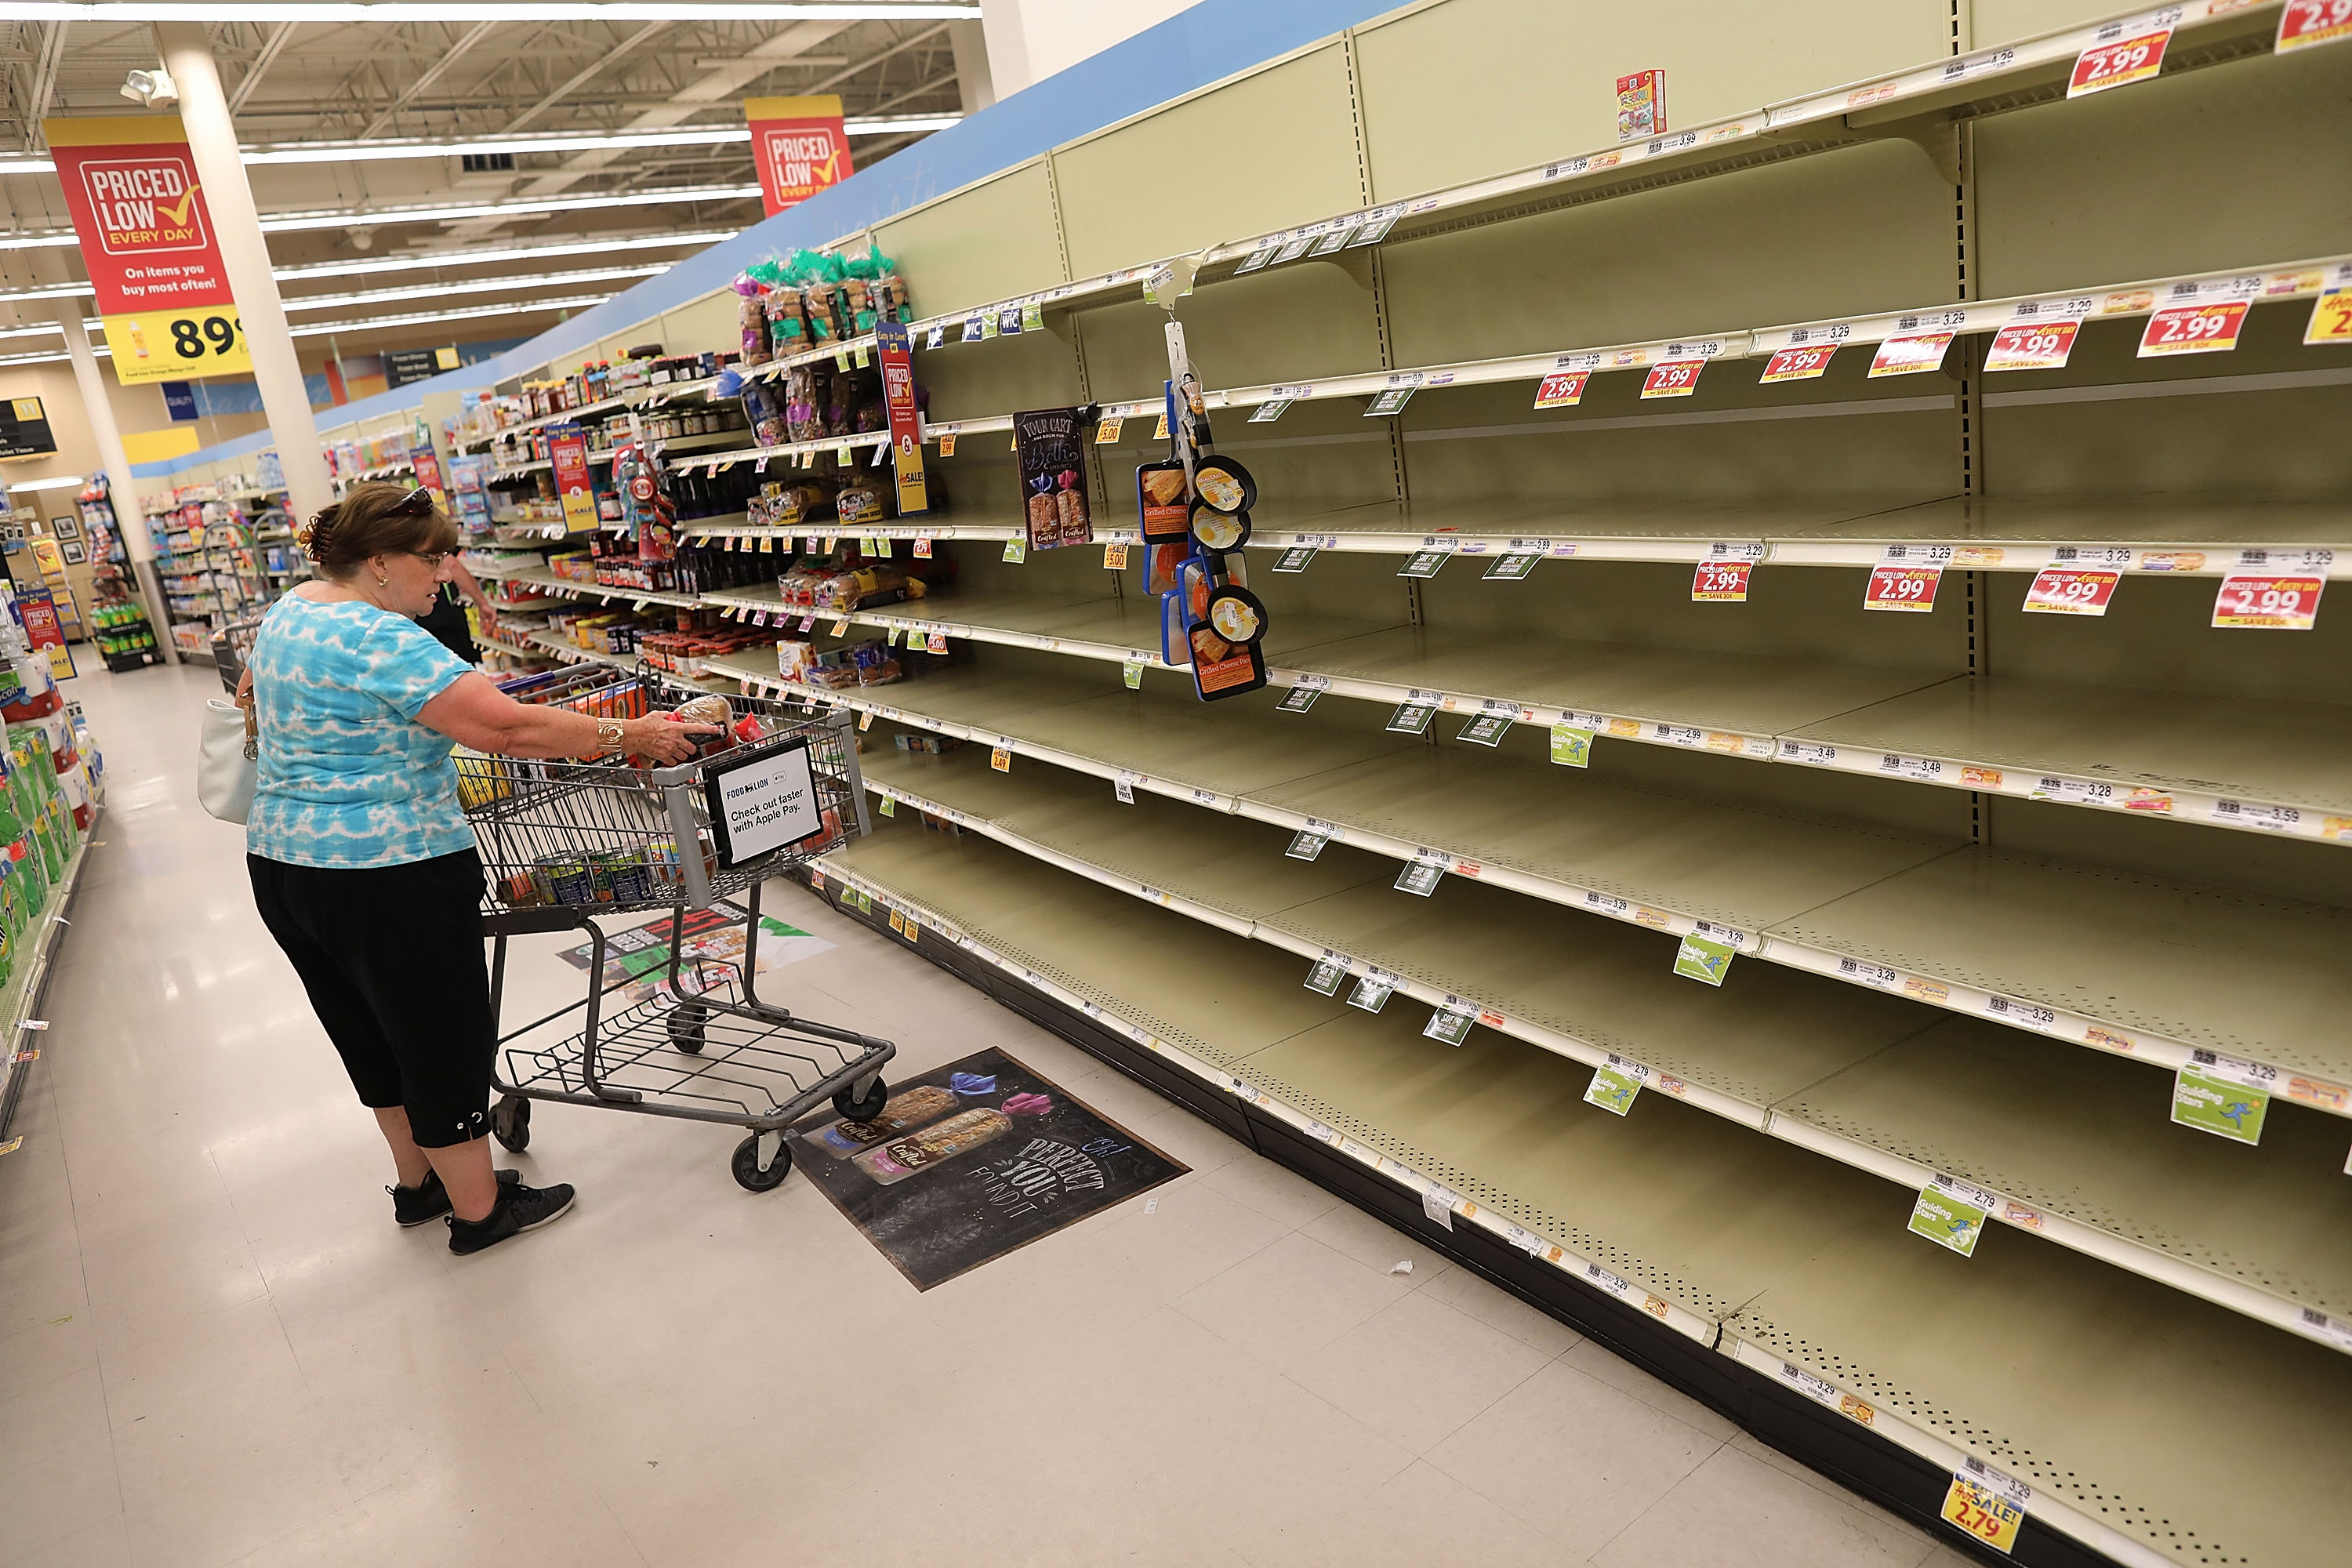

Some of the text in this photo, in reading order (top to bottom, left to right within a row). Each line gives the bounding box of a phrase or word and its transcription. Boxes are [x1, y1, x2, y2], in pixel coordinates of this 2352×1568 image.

[2087, 45, 2150, 81] 2.99
[1679, 133, 1696, 145] 3.99
[772, 136, 829, 163] PRICED
[776, 162, 811, 187] LOW
[91, 168, 183, 200] PRICED
[781, 186, 814, 198] EVERY
[100, 201, 156, 231] LOW
[110, 228, 194, 245] EVERY DAY
[125, 265, 205, 279] On items you
[122, 278, 216, 296] buy most often!
[2067, 300, 2092, 313] 3.29
[1943, 312, 1965, 325] 3.29
[1830, 326, 1849, 339] 3.29
[2160, 315, 2226, 342] 2.99
[1921, 336, 1937, 345] EVERY
[2003, 336, 2059, 358] 2.99
[1700, 343, 1717, 354] 3.29
[1585, 354, 1600, 365] 3.29
[1777, 353, 1820, 373] 2.99
[887, 368, 908, 383] PRICED
[1653, 369, 1690, 388] 2.99
[890, 383, 902, 397] LOW
[1545, 381, 1577, 398] 2.99
[20, 402, 36, 416] 11
[1023, 418, 1073, 437] YOUR CART
[557, 448, 579, 459] PRICED
[558, 457, 572, 466] LOW
[906, 471, 924, 483] SALE!
[1746, 545, 1762, 557] 3.29
[1930, 546, 1951, 559] 3.29
[2106, 550, 2130, 562] 3.29
[1703, 572, 1739, 590] 2.99
[1910, 572, 1927, 581] EVERY
[1879, 579, 1925, 600] 2.99
[2042, 581, 2099, 602] 2.99
[2233, 590, 2301, 614] 2.99
[31, 618, 43, 626] LOW
[1200, 664, 1219, 675] Grilled
[1220, 660, 1239, 670] Cheese
[1589, 716, 1602, 725] 2.99
[1686, 730, 1700, 739] 2.99
[1818, 747, 1835, 758] 3.48
[994, 757, 1005, 768] 2.49
[1922, 760, 1940, 772] 3.48
[727, 788, 745, 800] FOOD
[753, 779, 768, 790] LION
[1119, 791, 1131, 800] PRICE
[2089, 784, 2111, 797] 3.28
[731, 788, 804, 822] Check out faster
[733, 806, 800, 833] with Apple Pay.
[2272, 808, 2299, 822] 3.59
[1613, 900, 1627, 911] 3.29
[1727, 931, 1744, 943] 3.29
[1679, 952, 1694, 963] Stars
[1682, 945, 1708, 960] Guiding
[1877, 969, 1895, 981] 3.29
[2032, 1009, 2053, 1022] 3.29
[1635, 1065, 1648, 1077] 2.79
[2249, 1065, 2276, 1080] 3.29
[1595, 1076, 1617, 1091] Guiding
[2177, 1094, 2204, 1109] Stars
[2178, 1083, 2224, 1105] Guiding
[841, 1122, 878, 1141] Crafted
[1081, 1137, 1132, 1158] Oh!
[892, 1145, 927, 1166] Crafted
[1014, 1138, 1104, 1192] PERFECT
[1000, 1160, 1058, 1197] YOU
[965, 1167, 1038, 1218] FOUND IT
[1974, 1191, 1994, 1207] 2.79
[1916, 1207, 1936, 1221] Stars
[1919, 1199, 1952, 1220] Guiding
[1614, 1277, 1628, 1290] 3.29
[1817, 1380, 1835, 1396] 3.29
[2009, 1481, 2030, 1499] 3.29
[1973, 1493, 2016, 1524] SALE!
[1956, 1501, 2000, 1536] 2.79
